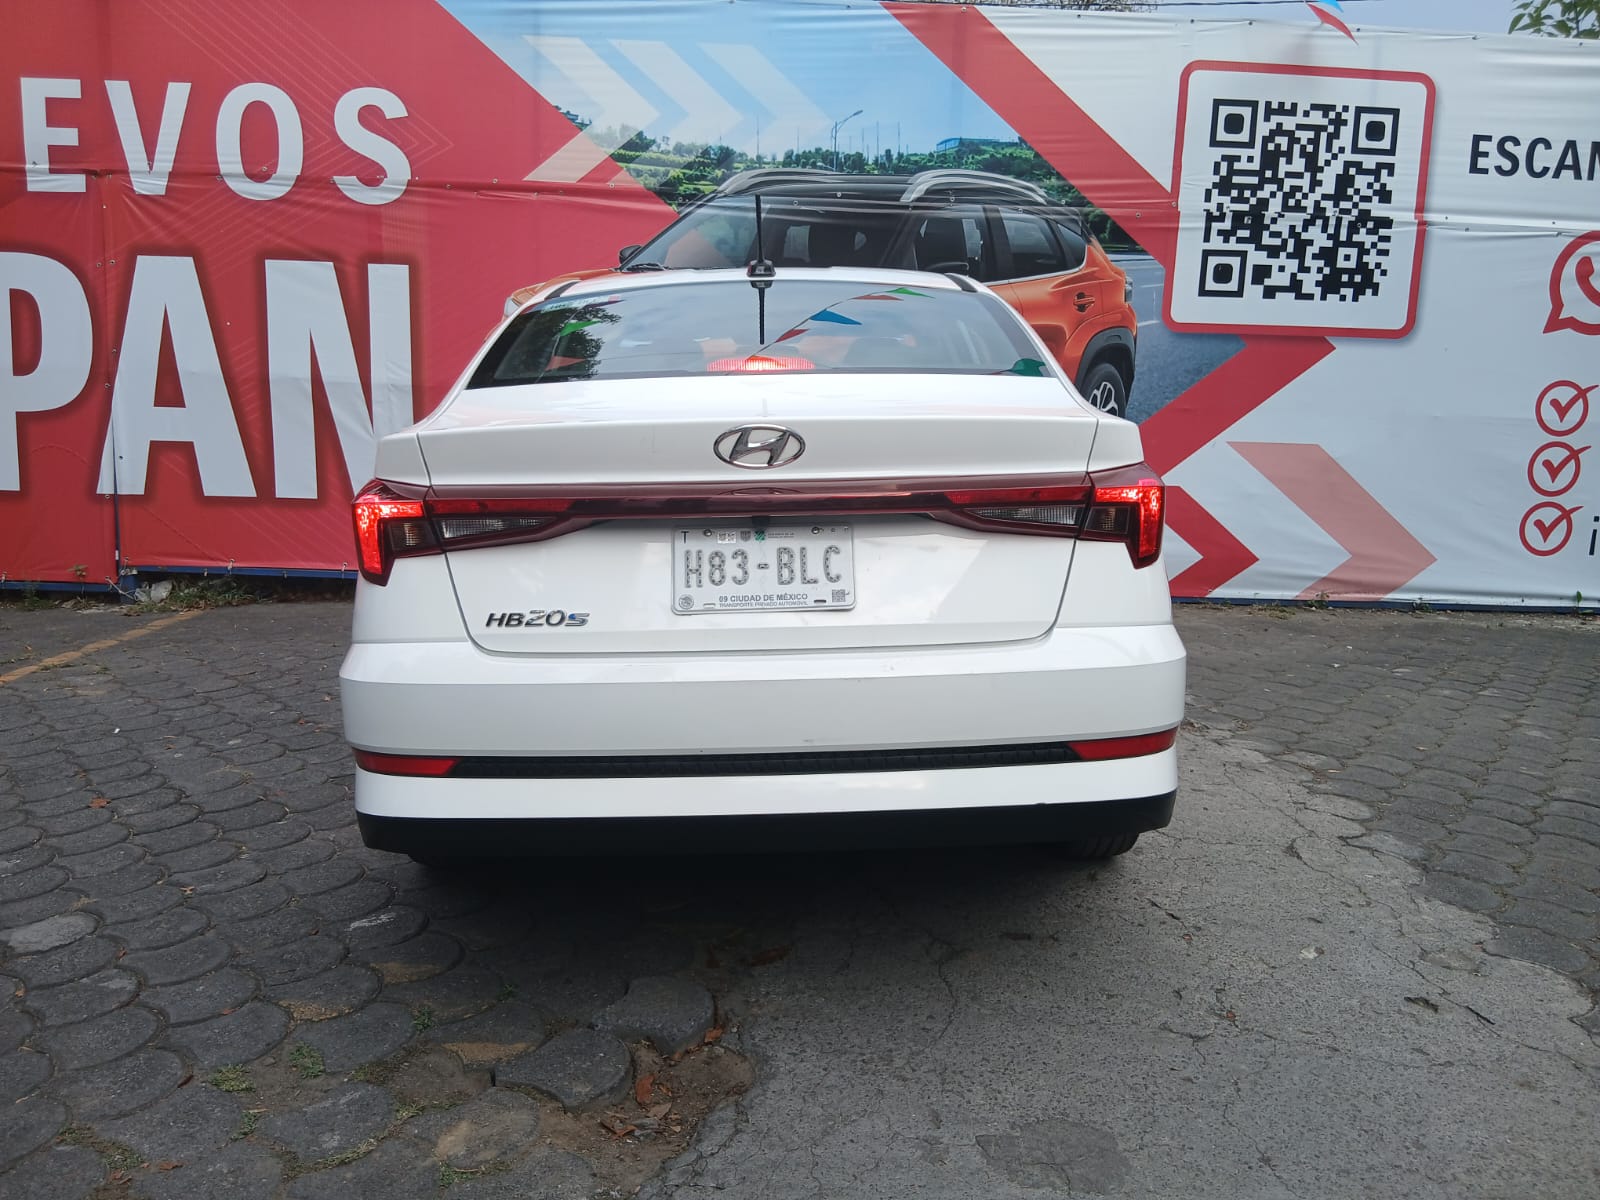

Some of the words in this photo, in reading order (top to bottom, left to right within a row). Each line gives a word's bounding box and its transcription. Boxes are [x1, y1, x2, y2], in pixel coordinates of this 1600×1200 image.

[20, 76, 412, 205] EVOS
[0, 251, 414, 499] PAN
[681, 531, 689, 544] T
[684, 545, 842, 588] H83-BLC
[719, 595, 729, 603] 09
[730, 594, 762, 602] CIUDAD
[763, 594, 775, 602] DE
[776, 592, 808, 601] MÉXICO
